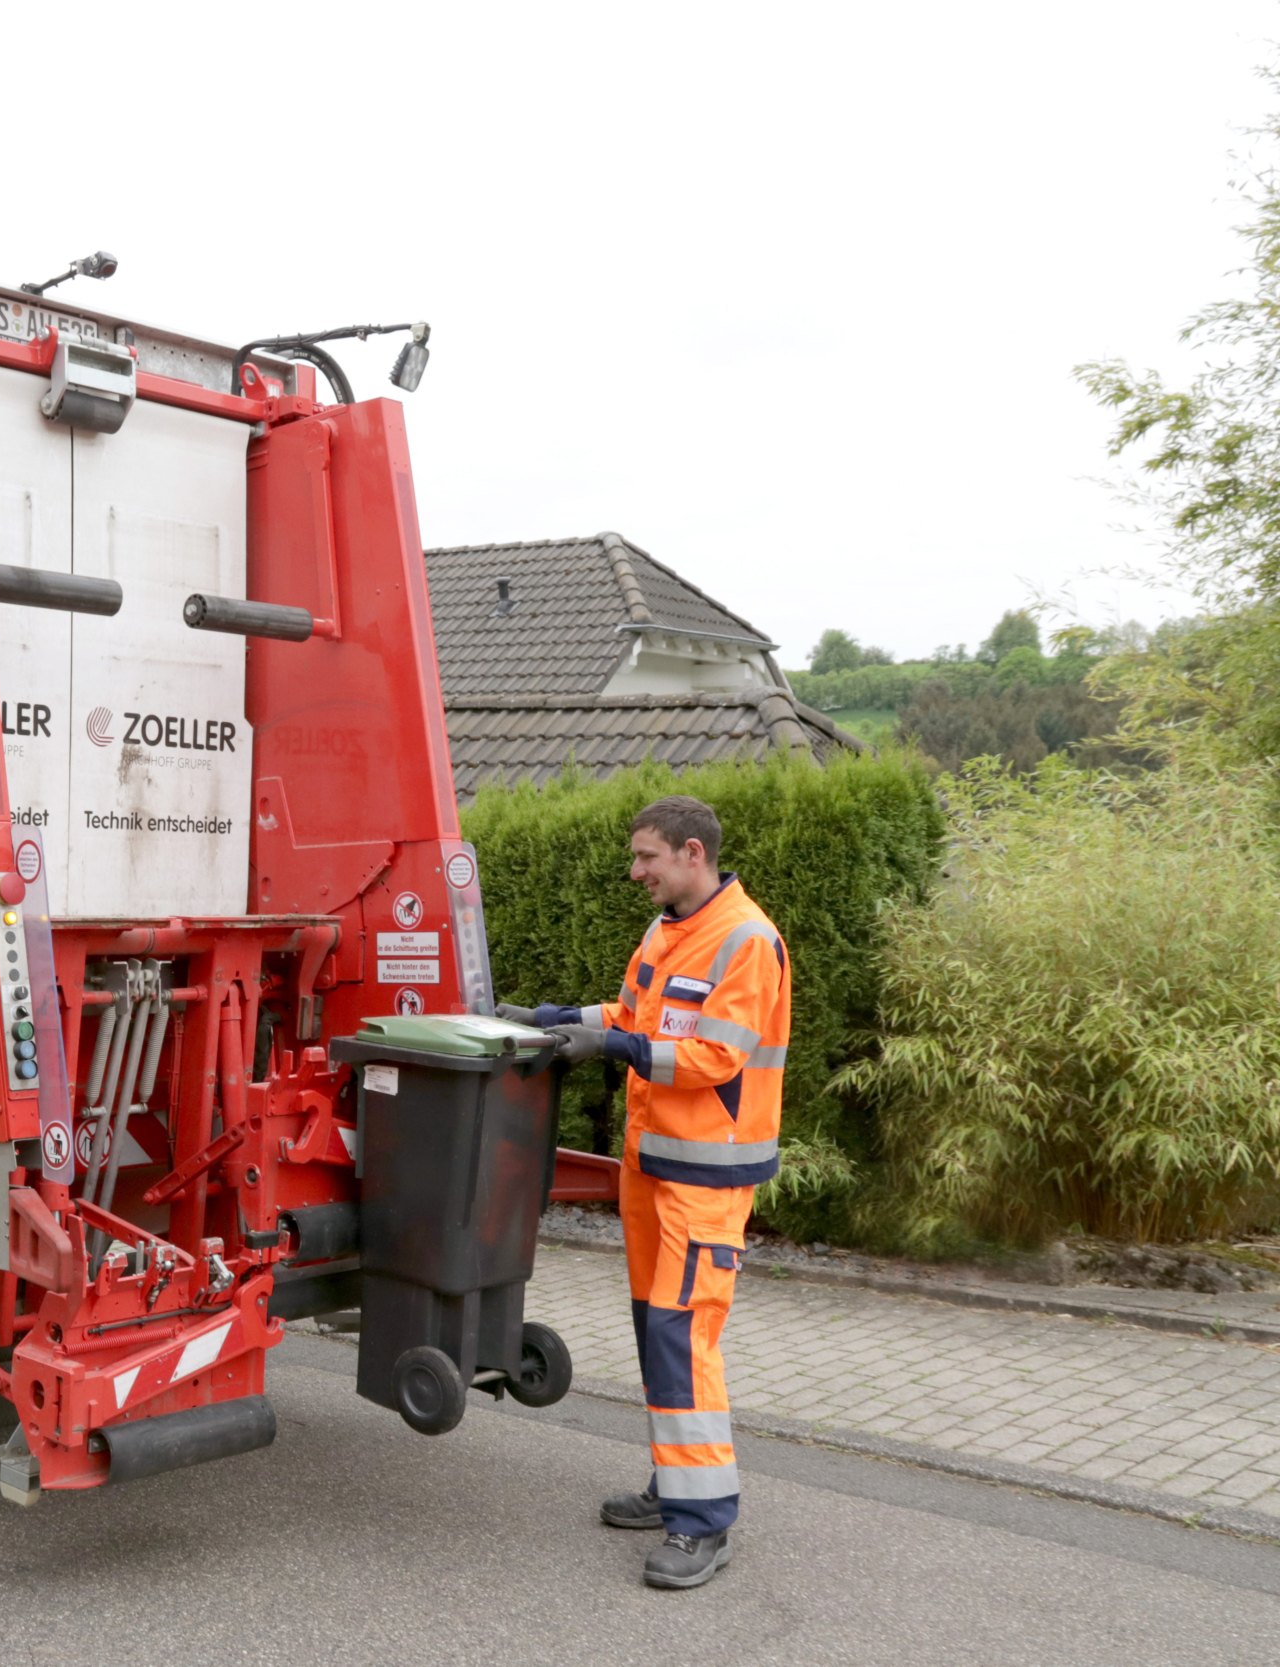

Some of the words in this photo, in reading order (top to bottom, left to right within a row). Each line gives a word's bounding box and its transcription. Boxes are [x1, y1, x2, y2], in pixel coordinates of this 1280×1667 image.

[123, 712, 236, 752] ZOELLER
[177, 757, 212, 771] GRUPPE
[84, 811, 142, 830] Technik
[148, 815, 232, 834] entscheidet
[393, 944, 418, 953] Schüttung
[420, 945, 438, 953] greifen
